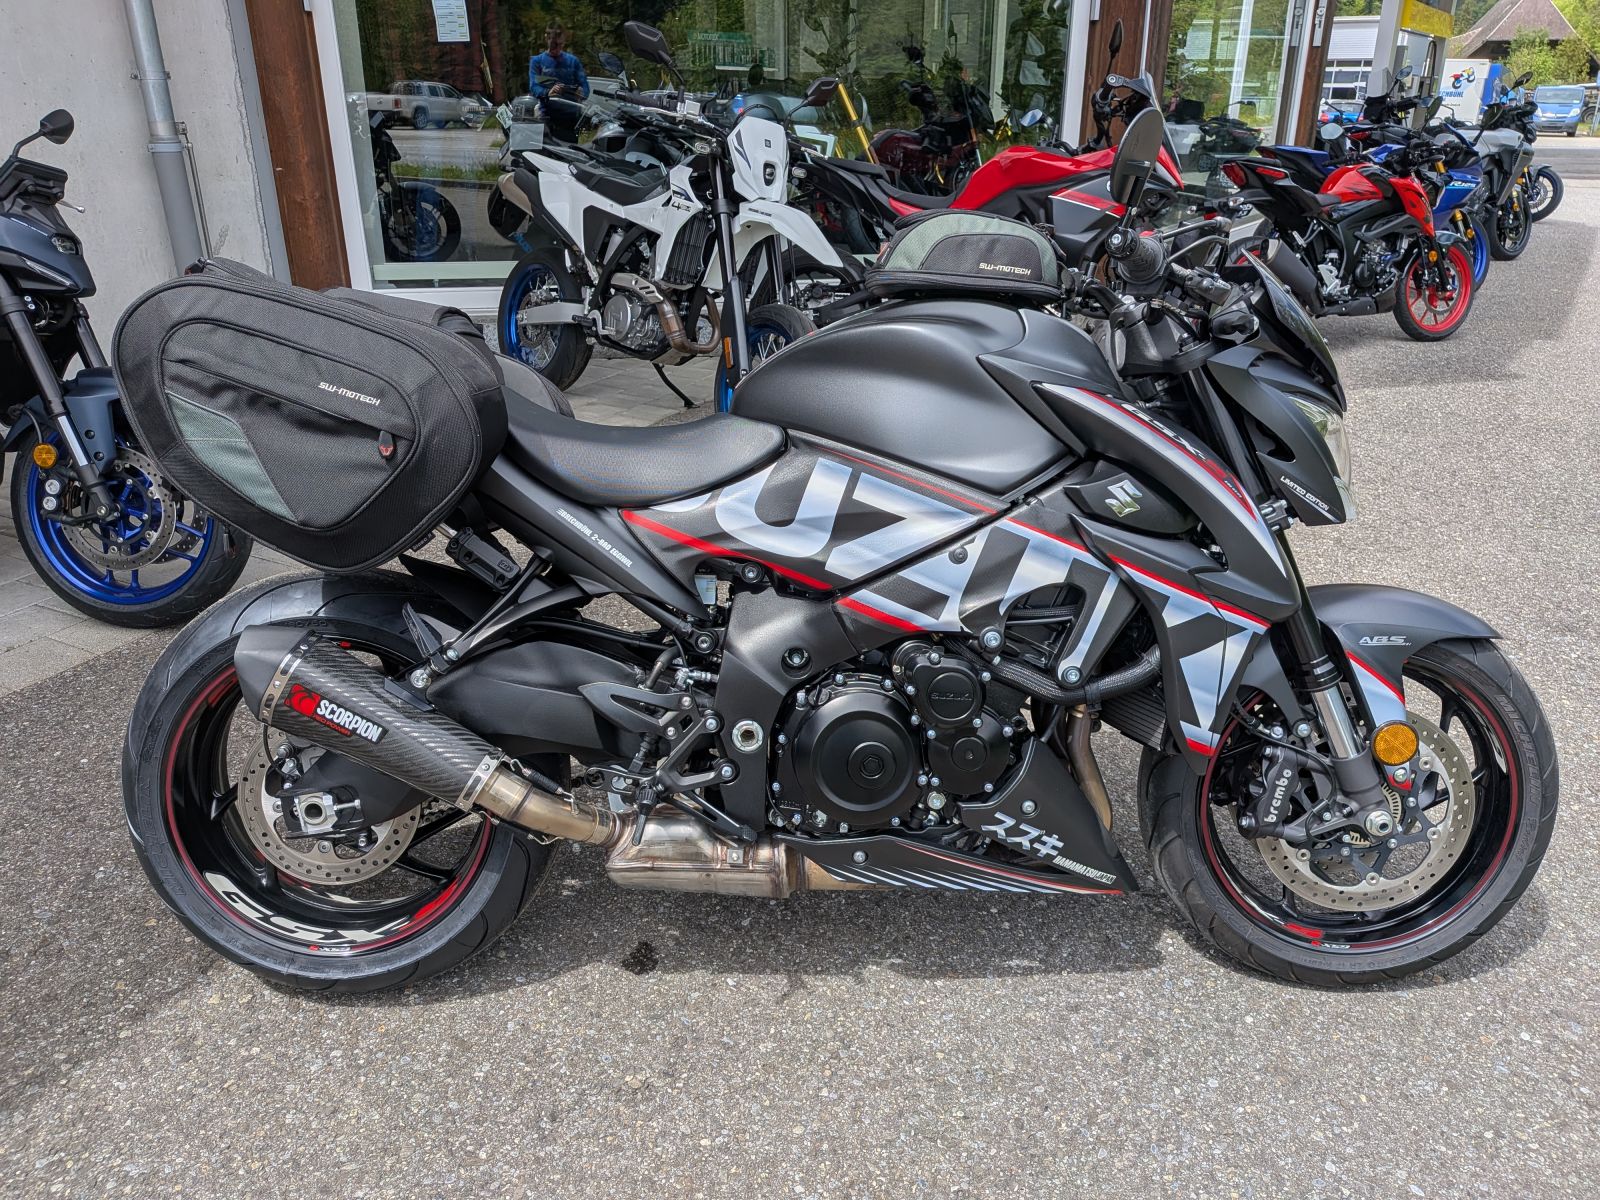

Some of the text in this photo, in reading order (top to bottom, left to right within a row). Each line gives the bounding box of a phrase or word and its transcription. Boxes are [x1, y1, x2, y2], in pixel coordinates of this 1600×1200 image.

[979, 262, 1031, 276] SW-MOTECH
[317, 381, 381, 406] SW-MOTECH
[1280, 475, 1330, 511] LIMITED EDITION
[1359, 635, 1407, 646] ABS
[316, 699, 383, 742] SCORPION
[1494, 694, 1542, 806] MICHELIN
[1263, 769, 1292, 823] brembo
[981, 811, 1064, 857] スズキ
